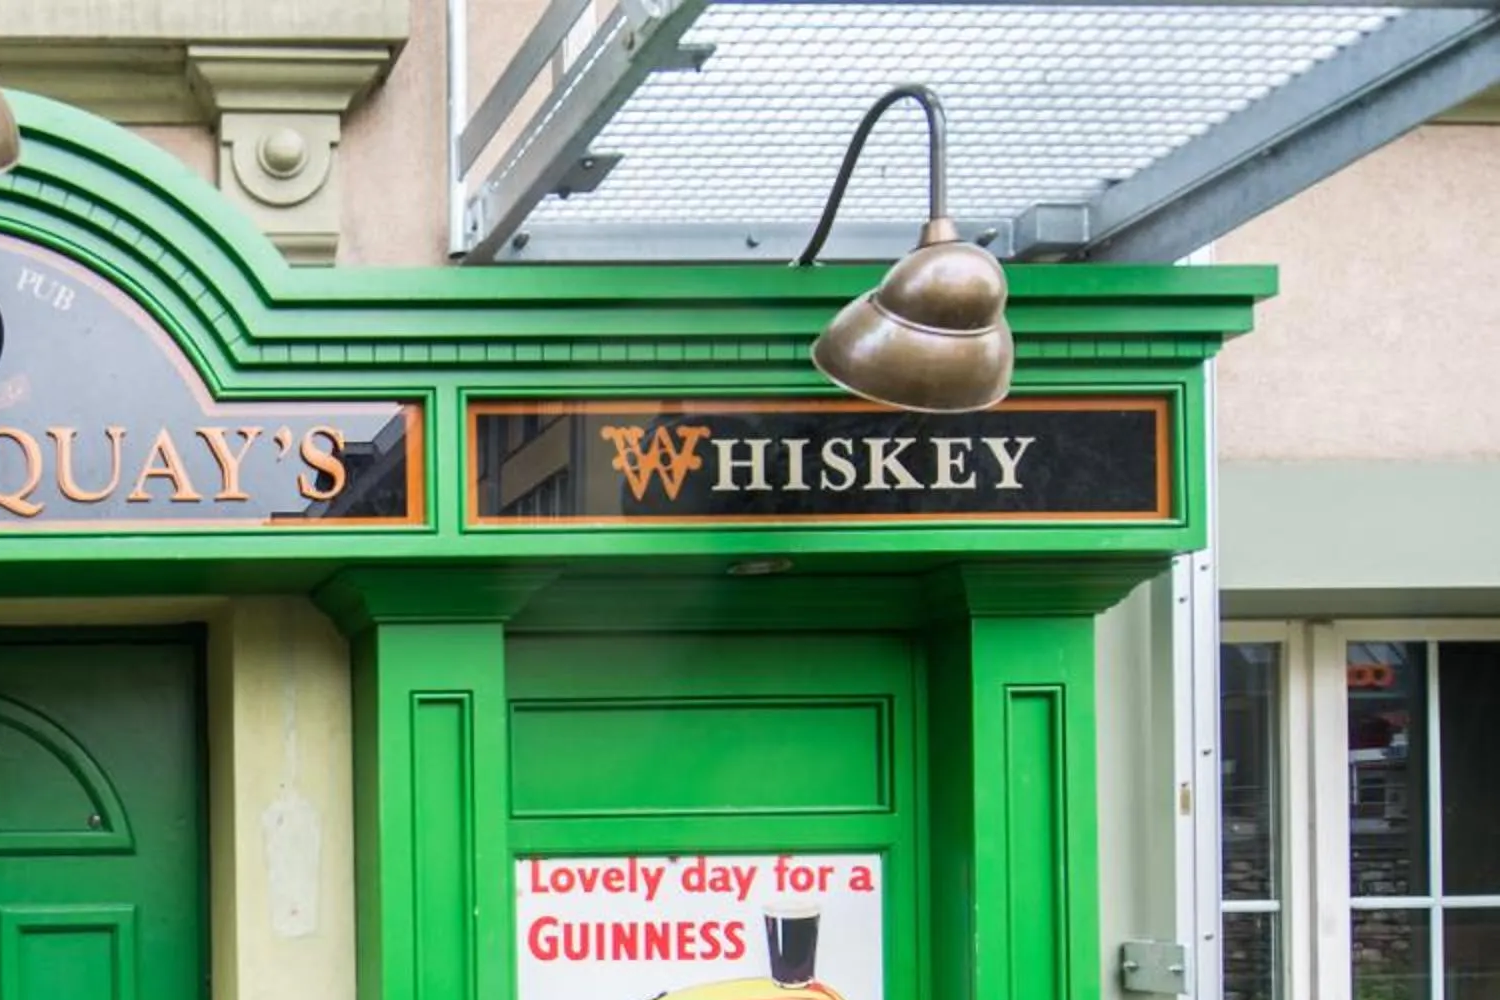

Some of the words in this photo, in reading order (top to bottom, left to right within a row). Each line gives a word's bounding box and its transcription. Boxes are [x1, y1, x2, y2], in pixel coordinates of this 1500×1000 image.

[16, 267, 77, 312] PUB
[599, 425, 1037, 501] WHISKEY
[530, 855, 666, 901] Lovely
[681, 855, 758, 901] day
[774, 854, 834, 892] for
[848, 864, 875, 892] a
[528, 915, 747, 961] GUINNESS
